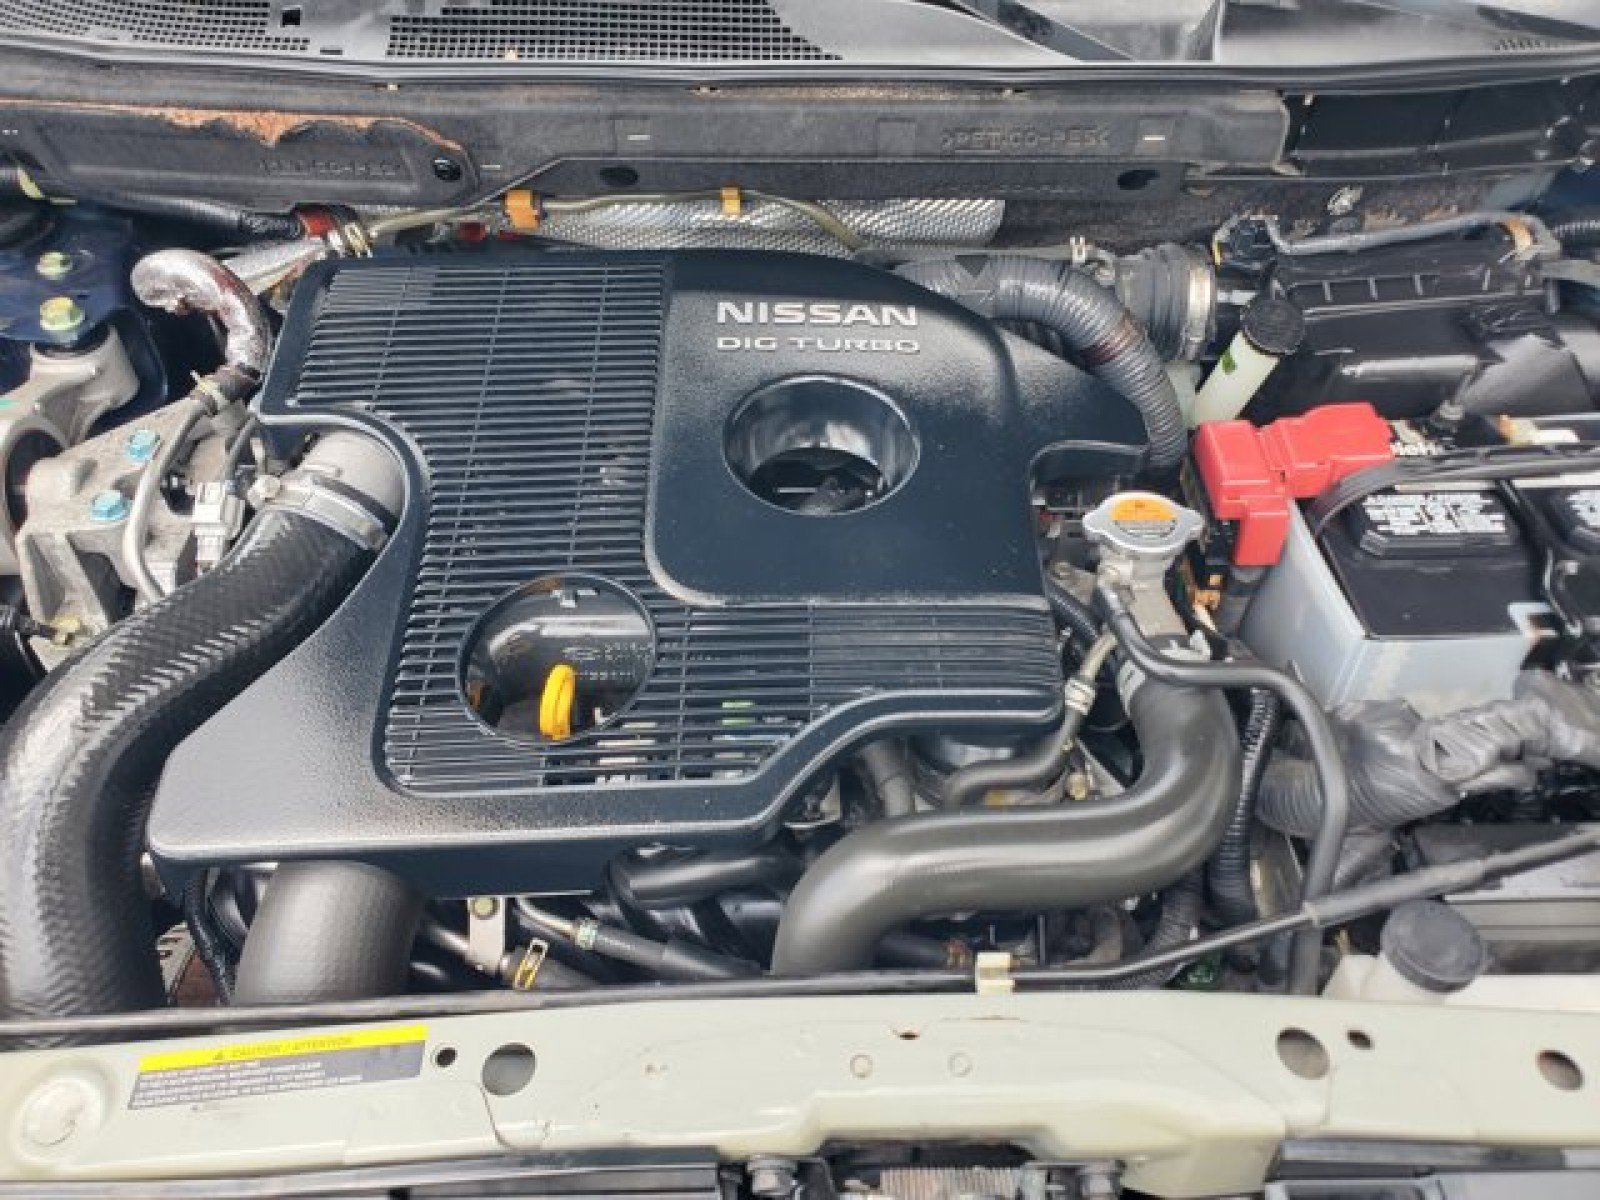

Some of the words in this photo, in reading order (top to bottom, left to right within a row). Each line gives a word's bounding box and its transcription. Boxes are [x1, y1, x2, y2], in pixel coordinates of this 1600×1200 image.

[717, 301, 919, 327] NISSAN
[717, 336, 778, 351] DIG
[788, 336, 921, 355] TURBO
